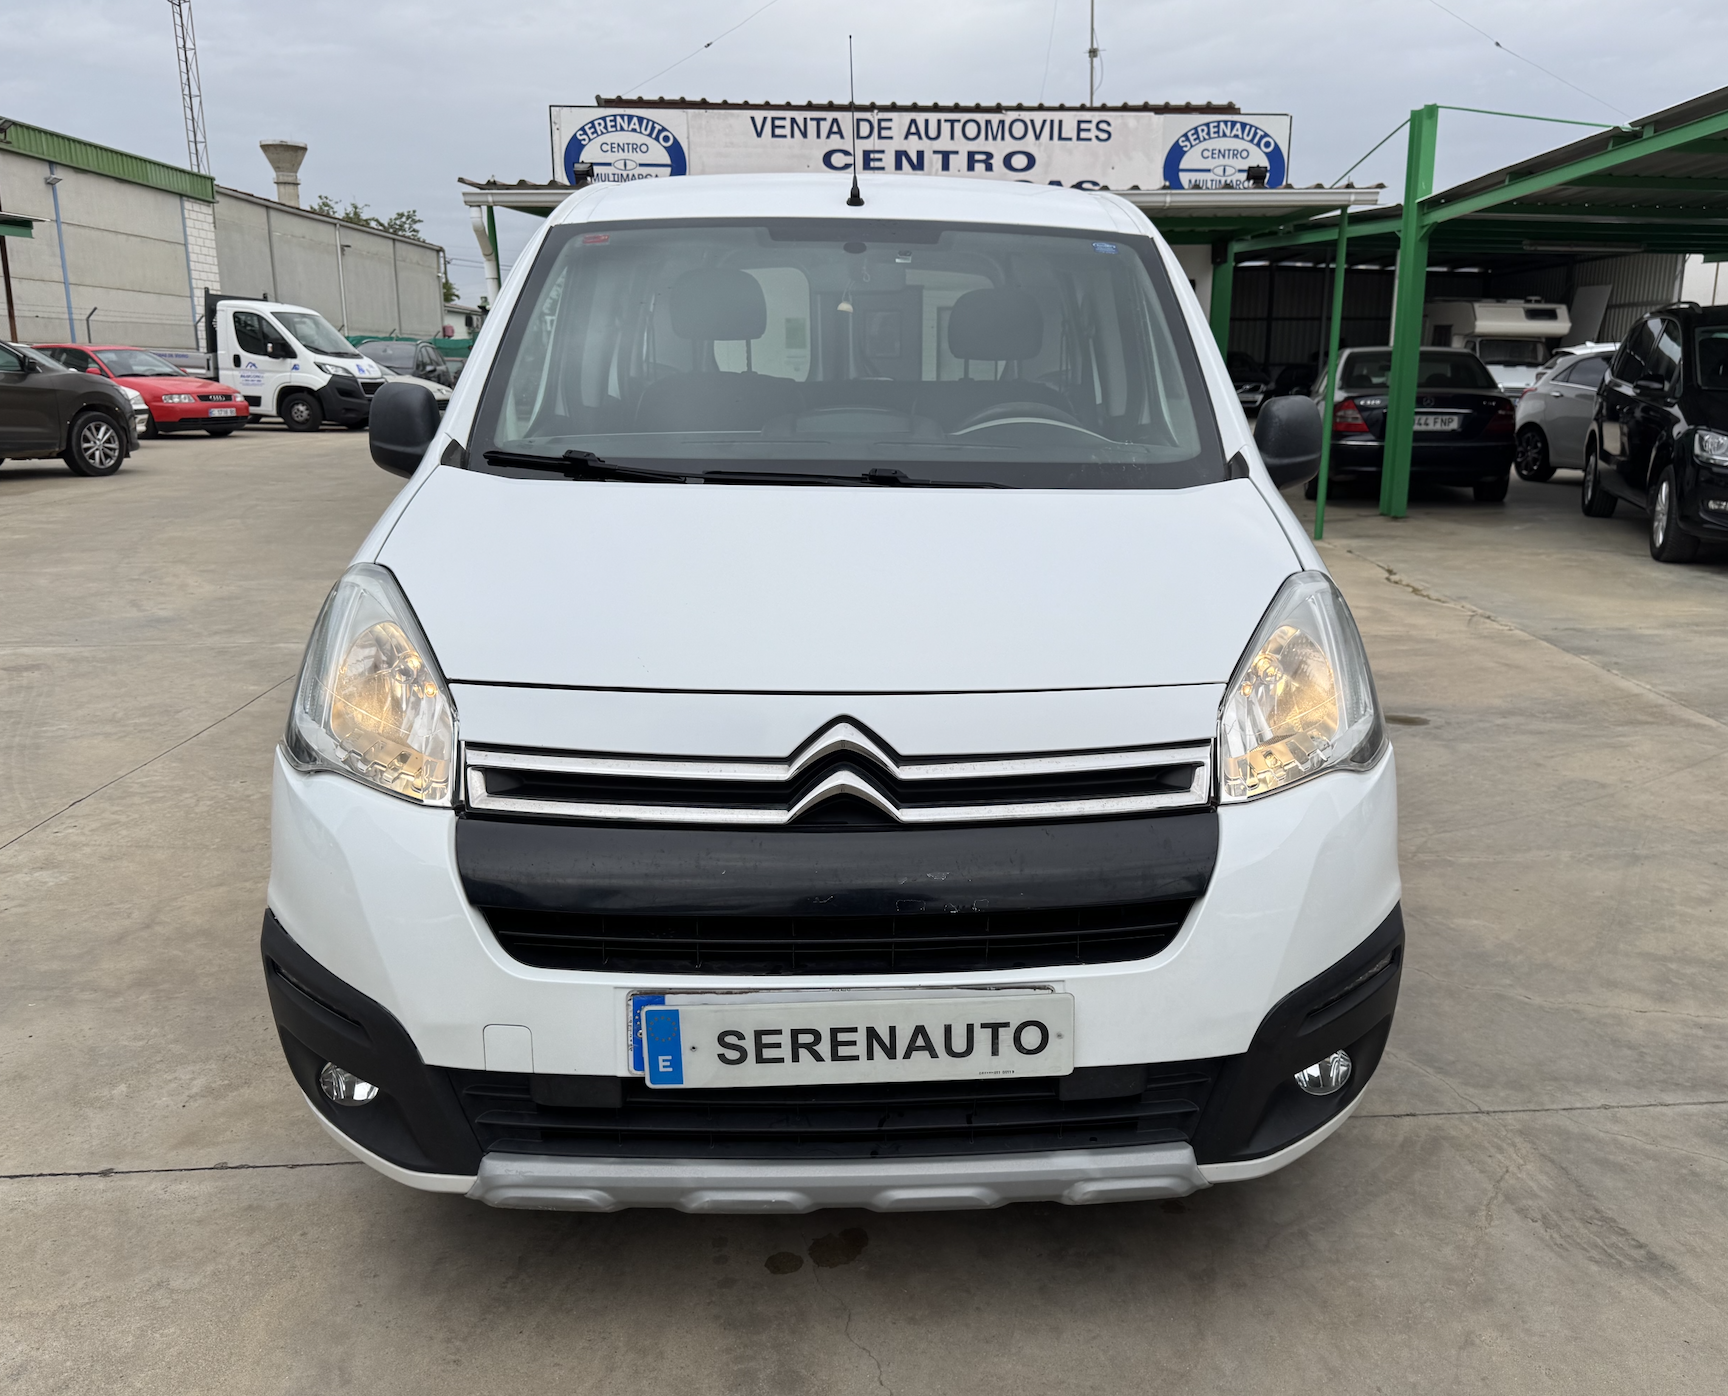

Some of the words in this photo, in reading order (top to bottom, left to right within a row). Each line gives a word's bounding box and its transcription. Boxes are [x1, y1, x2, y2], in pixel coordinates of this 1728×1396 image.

[576, 115, 674, 147] SERENAUTO
[750, 116, 846, 140] VENTA
[856, 118, 894, 140] DE
[904, 118, 1112, 142] AUTOMOVILES
[1178, 121, 1275, 153] SERENAUTO
[600, 142, 649, 154] CENTRO
[1201, 148, 1250, 160] CENTRO
[822, 149, 1036, 173] CENTRO
[1188, 179, 1251, 189] MULTIMARC
[1413, 417, 1429, 427] 44
[1433, 417, 1454, 428] FNP
[716, 1020, 1050, 1066] SERENAUTO
[658, 1055, 673, 1073] E
